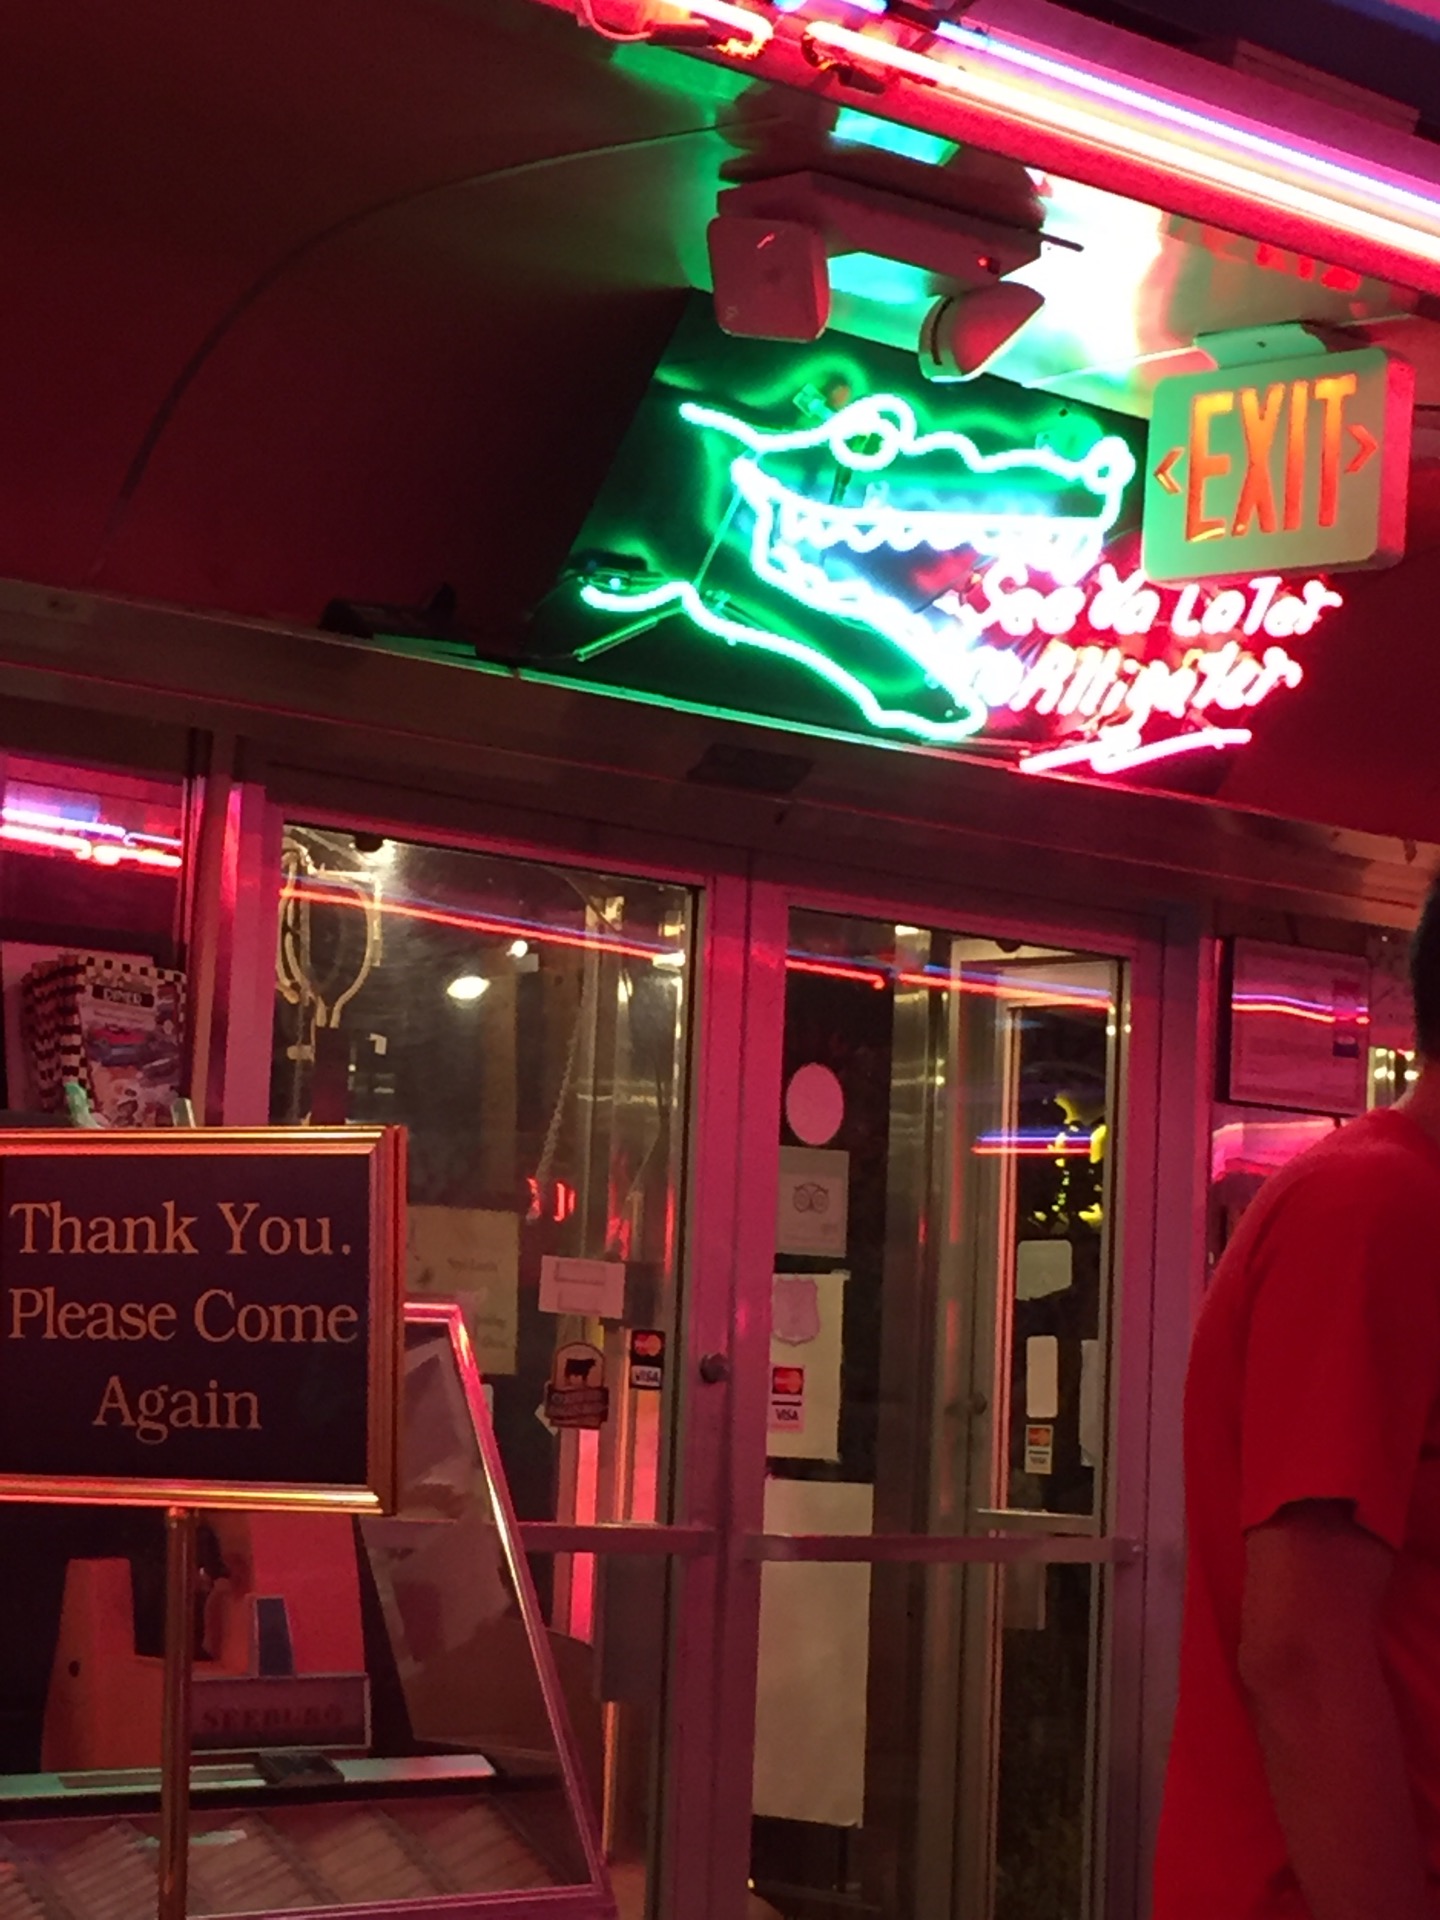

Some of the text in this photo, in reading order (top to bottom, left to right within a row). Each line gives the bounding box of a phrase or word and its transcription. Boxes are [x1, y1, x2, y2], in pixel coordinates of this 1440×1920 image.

[1186, 373, 1357, 543] EXIT
[936, 563, 1086, 635] See
[1088, 564, 1160, 635] Ya
[1000, 638, 1303, 748] Alligator
[9, 1200, 352, 1256] Thank You.
[8, 1286, 359, 1344] Please Come
[91, 1375, 263, 1445] Again
[775, 1408, 799, 1421] VISA
